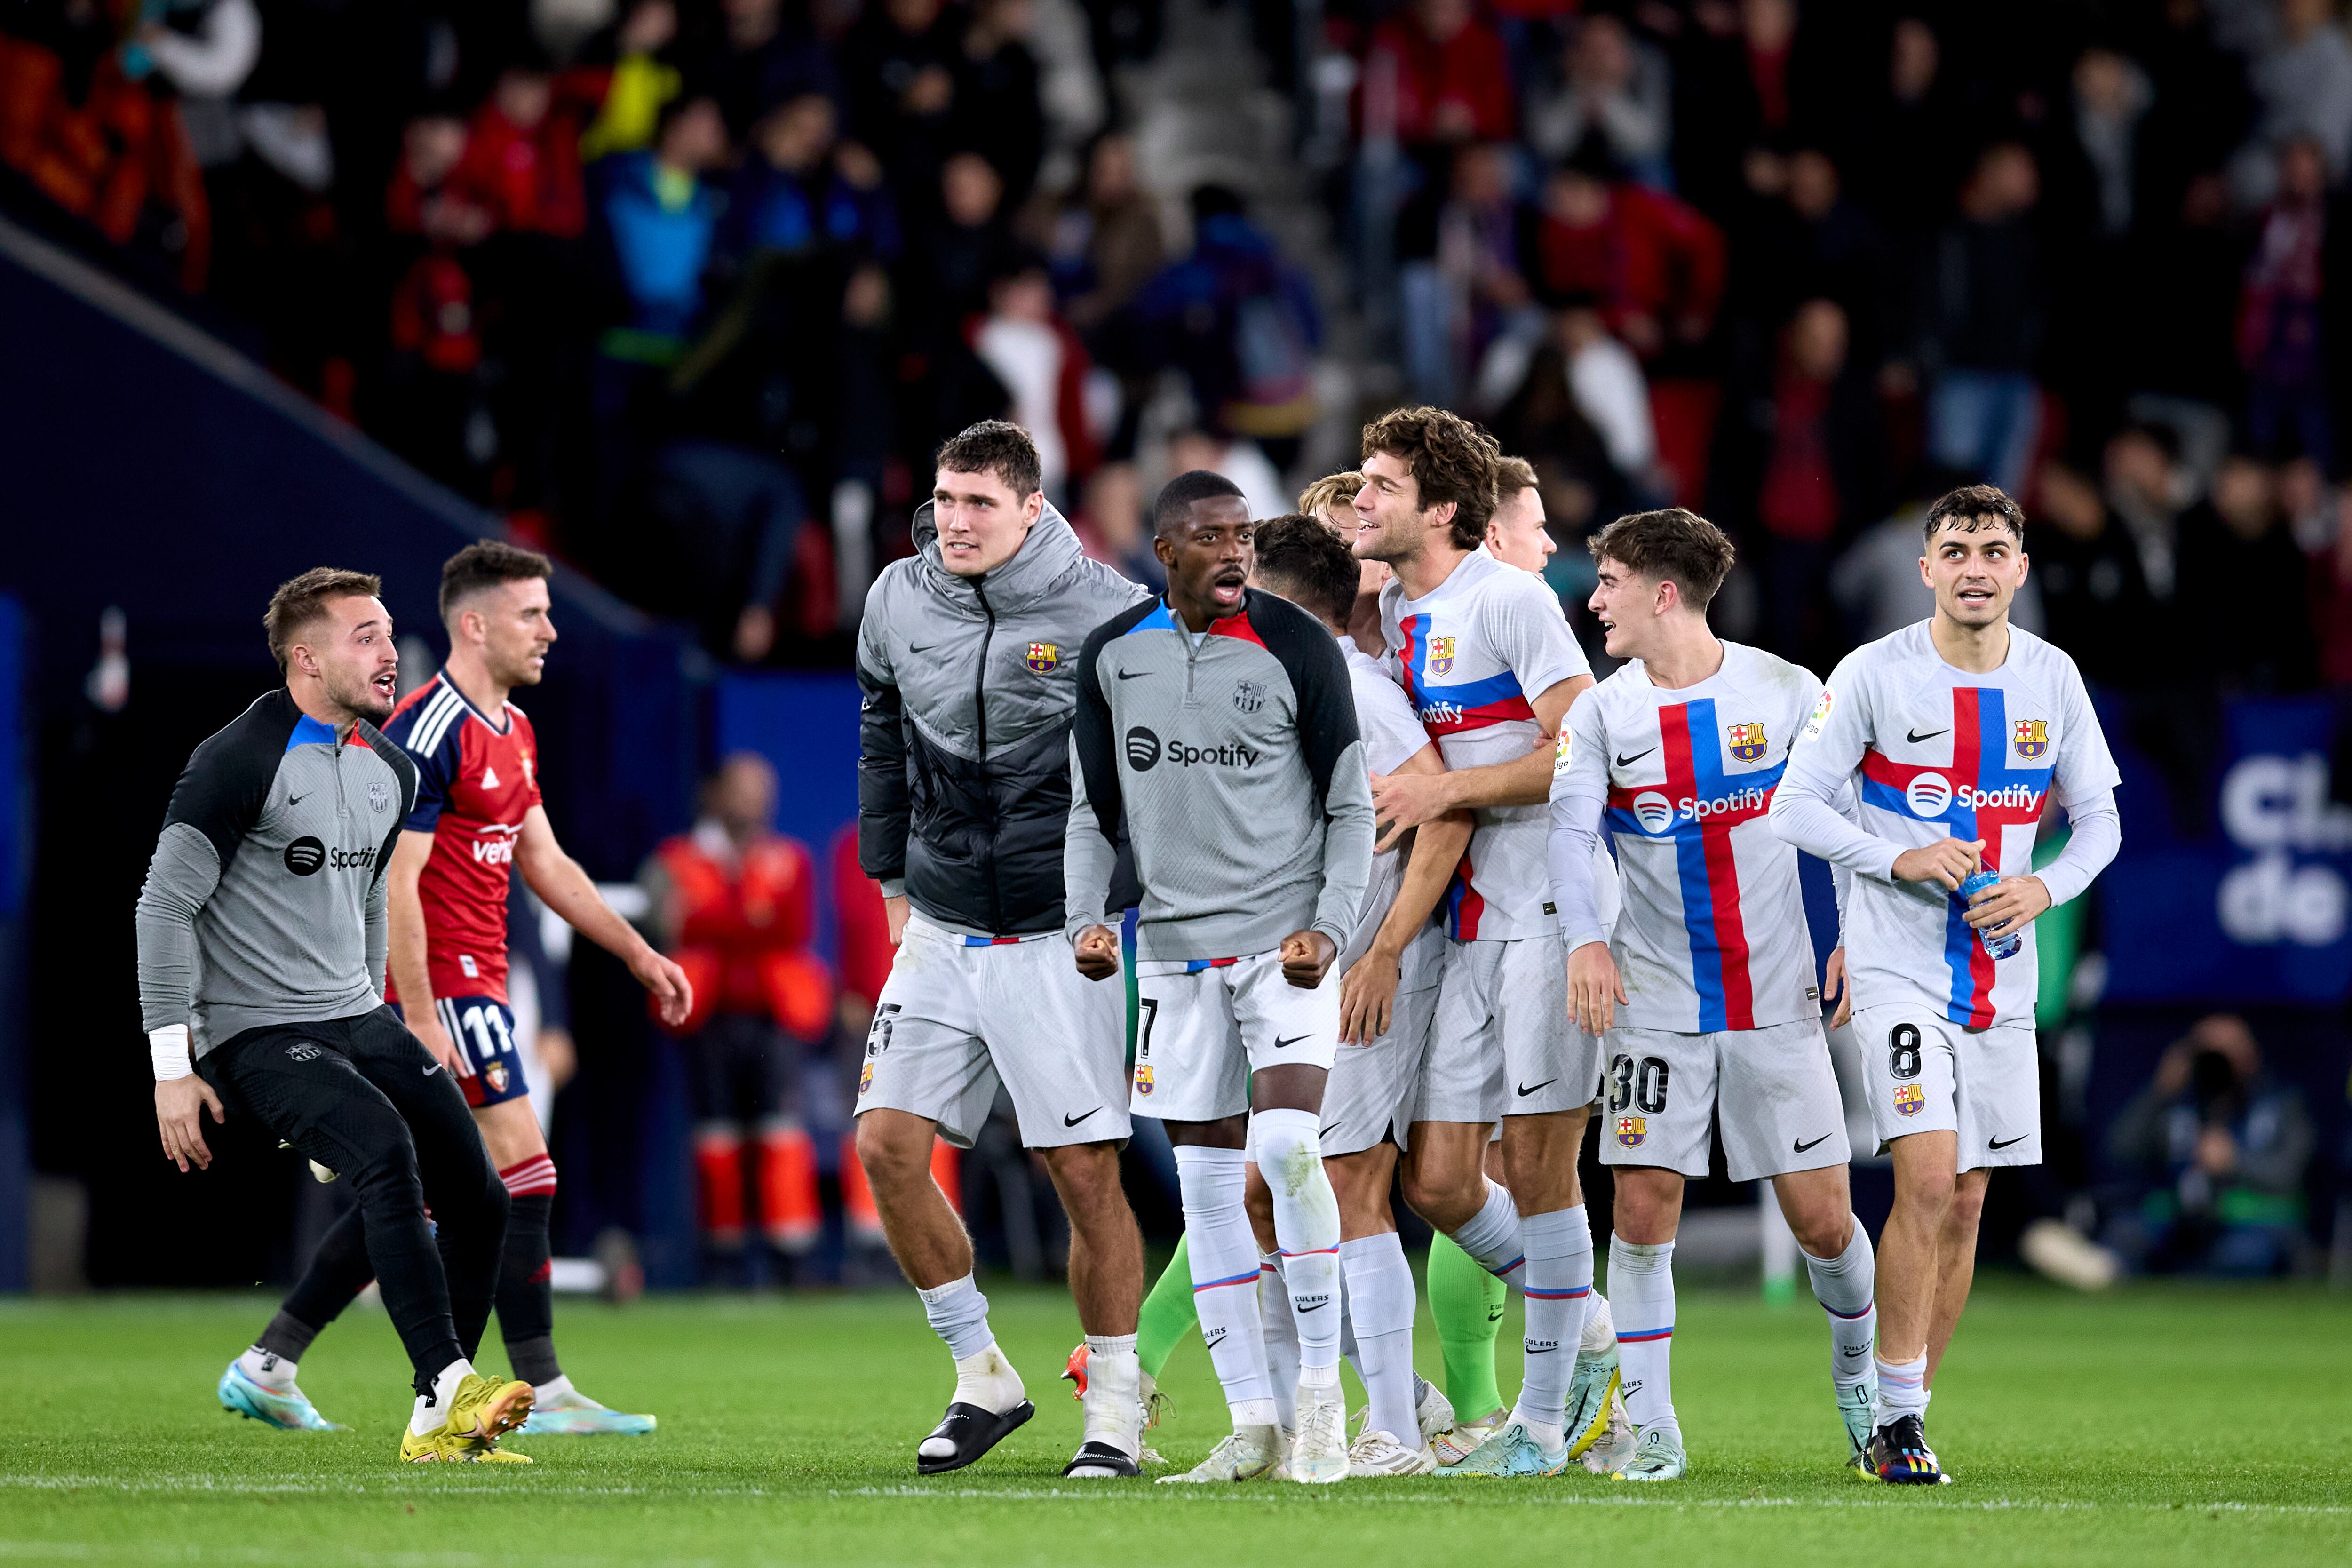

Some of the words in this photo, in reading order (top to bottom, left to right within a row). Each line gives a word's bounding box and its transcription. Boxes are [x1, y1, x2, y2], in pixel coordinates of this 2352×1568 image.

[1167, 740, 1259, 770] Spotify
[1554, 760, 1569, 770] iga
[1678, 787, 1764, 822] Spotify
[1957, 783, 2041, 812] Spotify
[462, 1004, 512, 1059] 11
[1140, 997, 1158, 1059] 7
[1888, 1023, 1922, 1080] 8
[1609, 1053, 1669, 1115] 30
[1295, 1294, 1329, 1302] CULERS
[1525, 1338, 1558, 1347] CULERS
